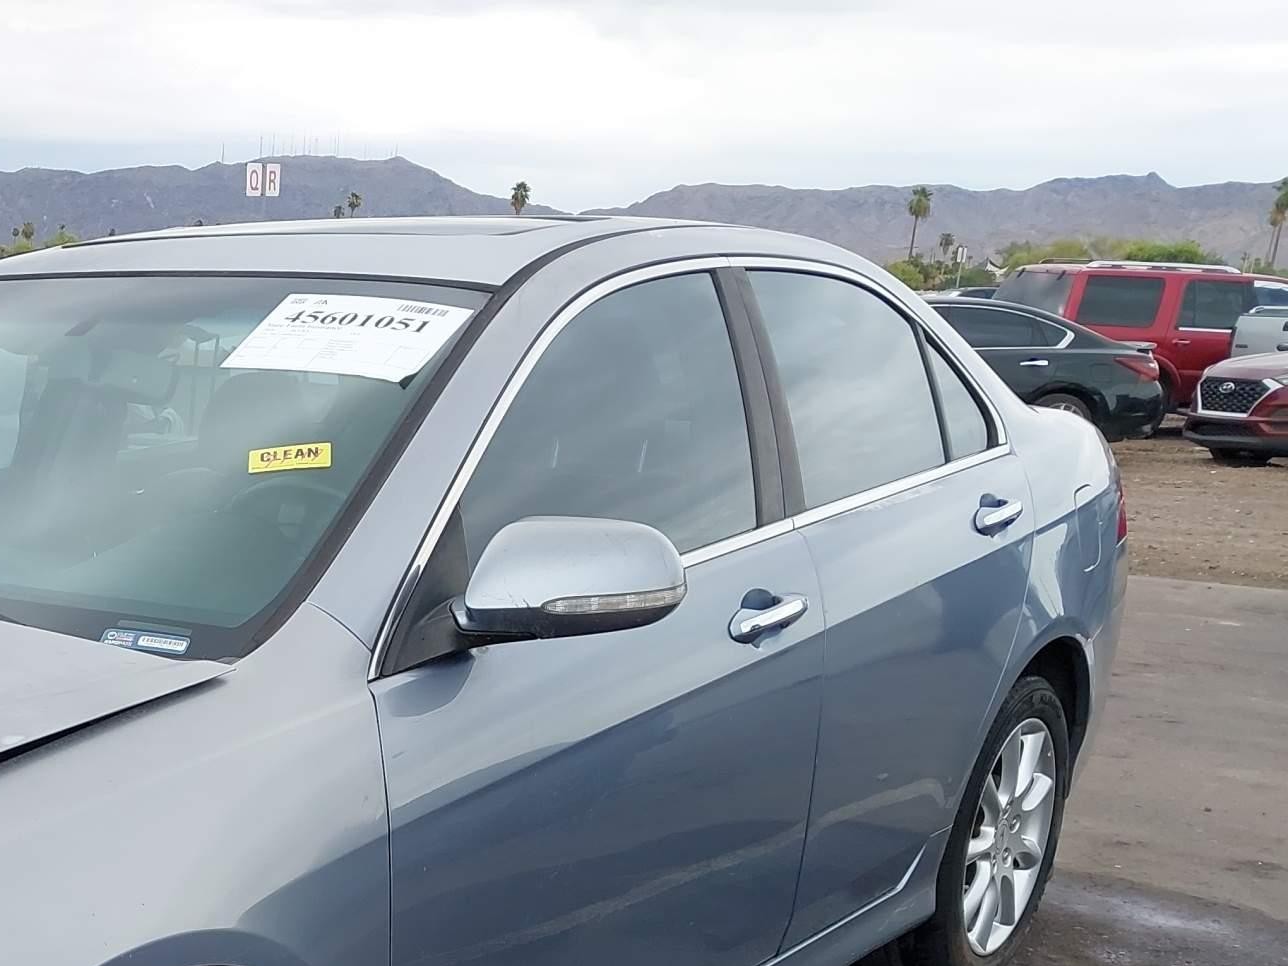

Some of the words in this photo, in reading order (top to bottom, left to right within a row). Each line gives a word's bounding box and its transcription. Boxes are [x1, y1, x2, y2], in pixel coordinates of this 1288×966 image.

[249, 169, 259, 191] Q
[268, 170, 277, 192] R
[284, 309, 431, 333] 45601051
[259, 446, 319, 463] CLEAN
